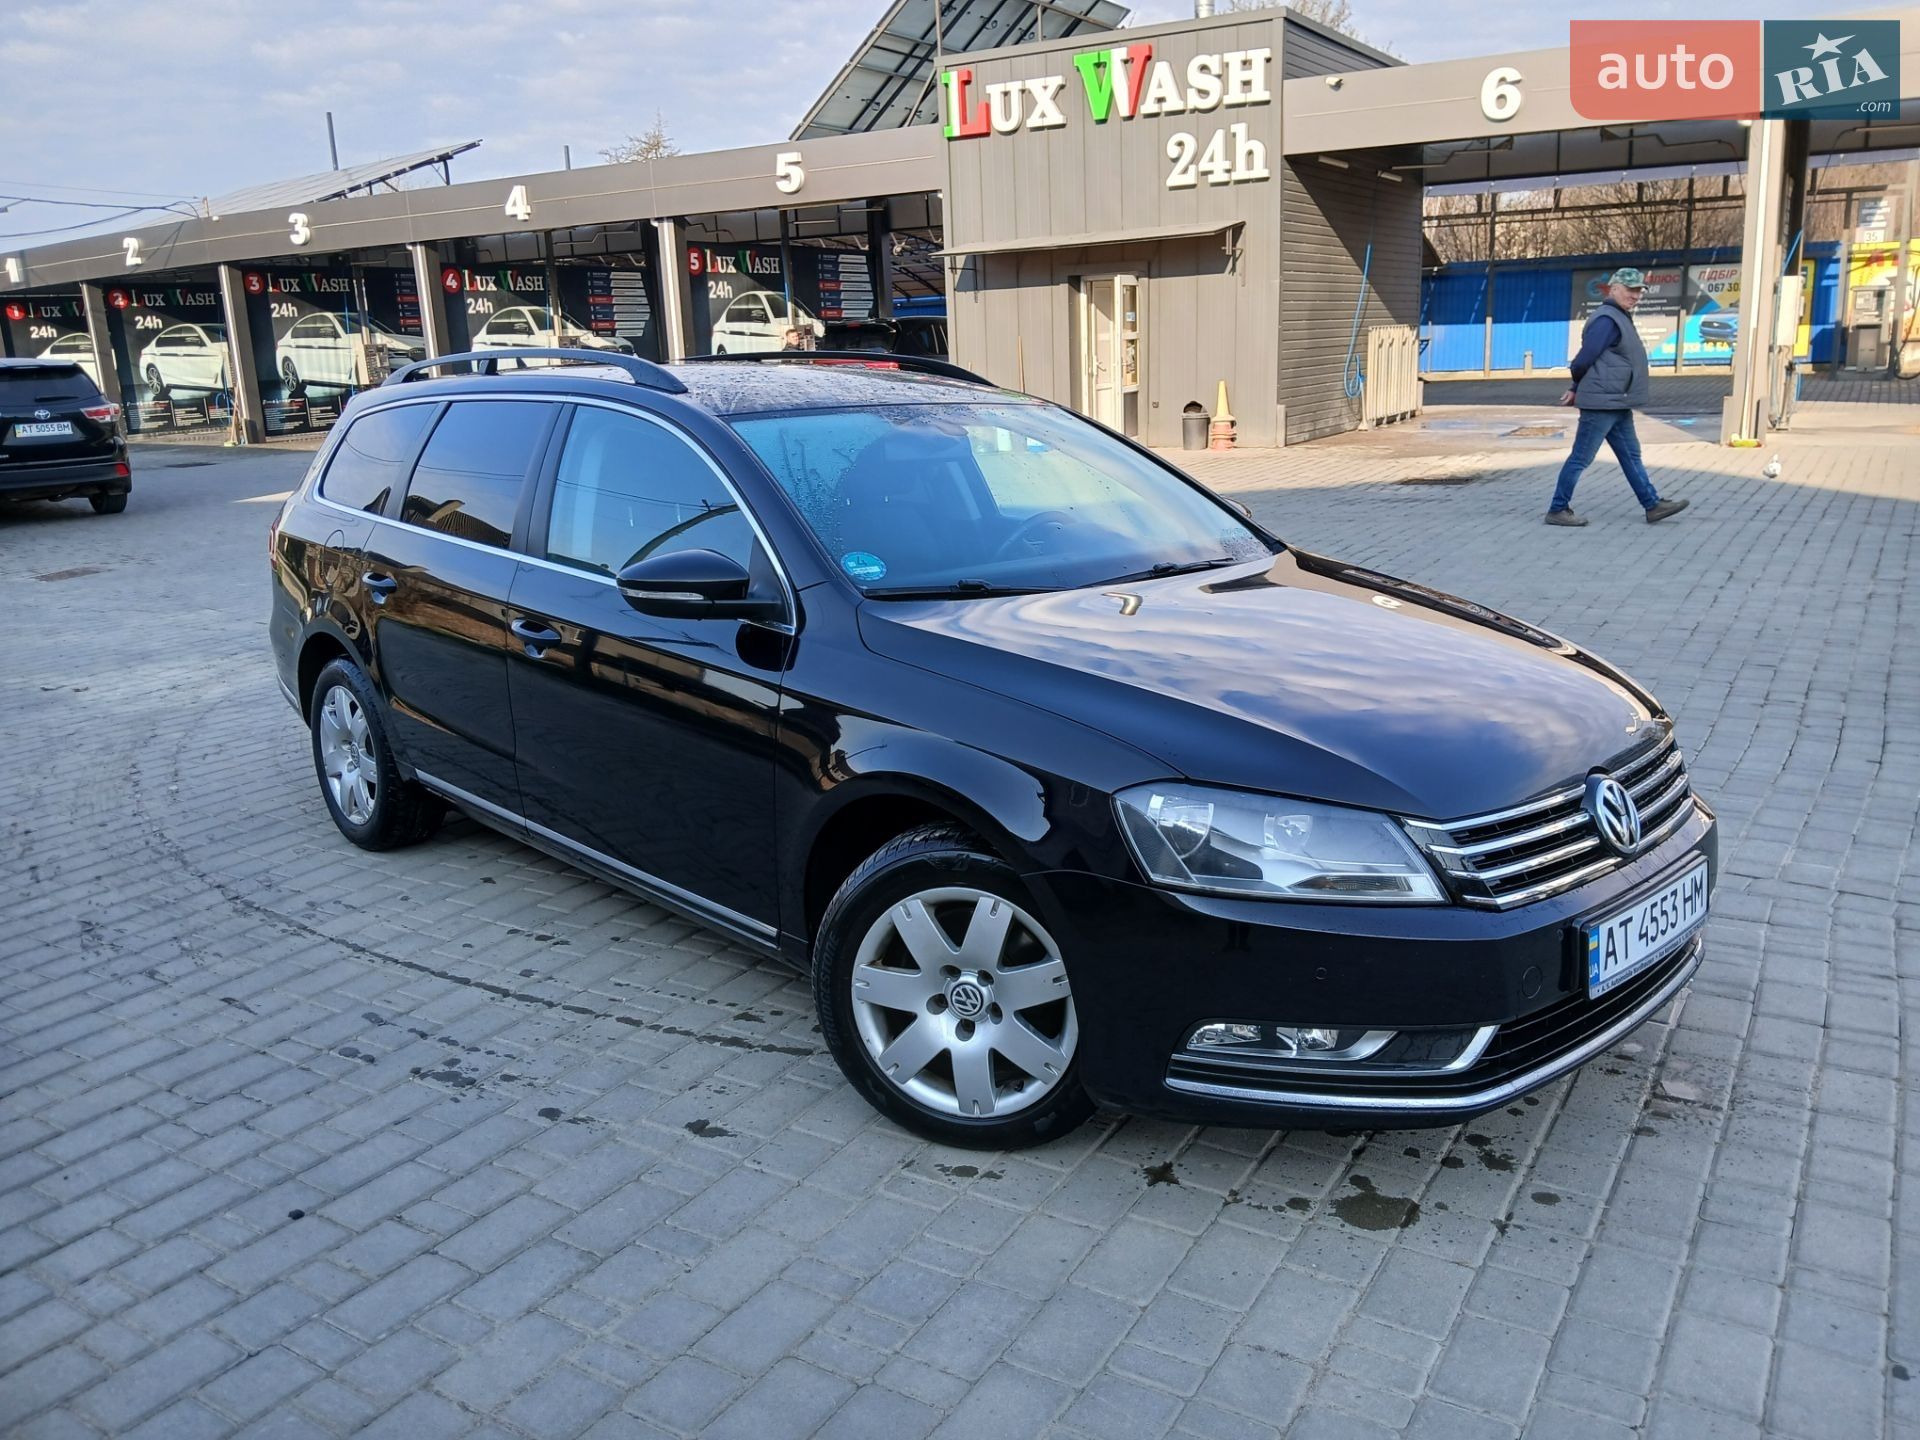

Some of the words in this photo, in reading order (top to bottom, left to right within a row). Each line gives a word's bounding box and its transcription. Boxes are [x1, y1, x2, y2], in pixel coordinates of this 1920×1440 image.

[941, 70, 1067, 139] LUX
[1074, 44, 1271, 121] WASH
[1480, 66, 1523, 120] 6
[1166, 122, 1270, 188] 24h
[775, 152, 805, 193] 5
[505, 185, 532, 220] 4
[288, 212, 311, 245] 3
[123, 237, 142, 266] 2
[6, 257, 22, 283] 1
[690, 252, 700, 271] 5
[248, 276, 260, 291] 3
[446, 274, 458, 289] 4
[708, 281, 733, 299] 24h
[1707, 282, 1725, 293] 067
[113, 293, 124, 305] 2
[466, 298, 494, 314] 24h
[270, 303, 298, 318] 24h
[134, 315, 163, 330] 24h
[29, 326, 57, 339] 24h
[36, 424, 55, 433] 5055
[1604, 916, 1633, 971] AT
[1638, 888, 1678, 947] 4553
[1682, 869, 1704, 921] HM
